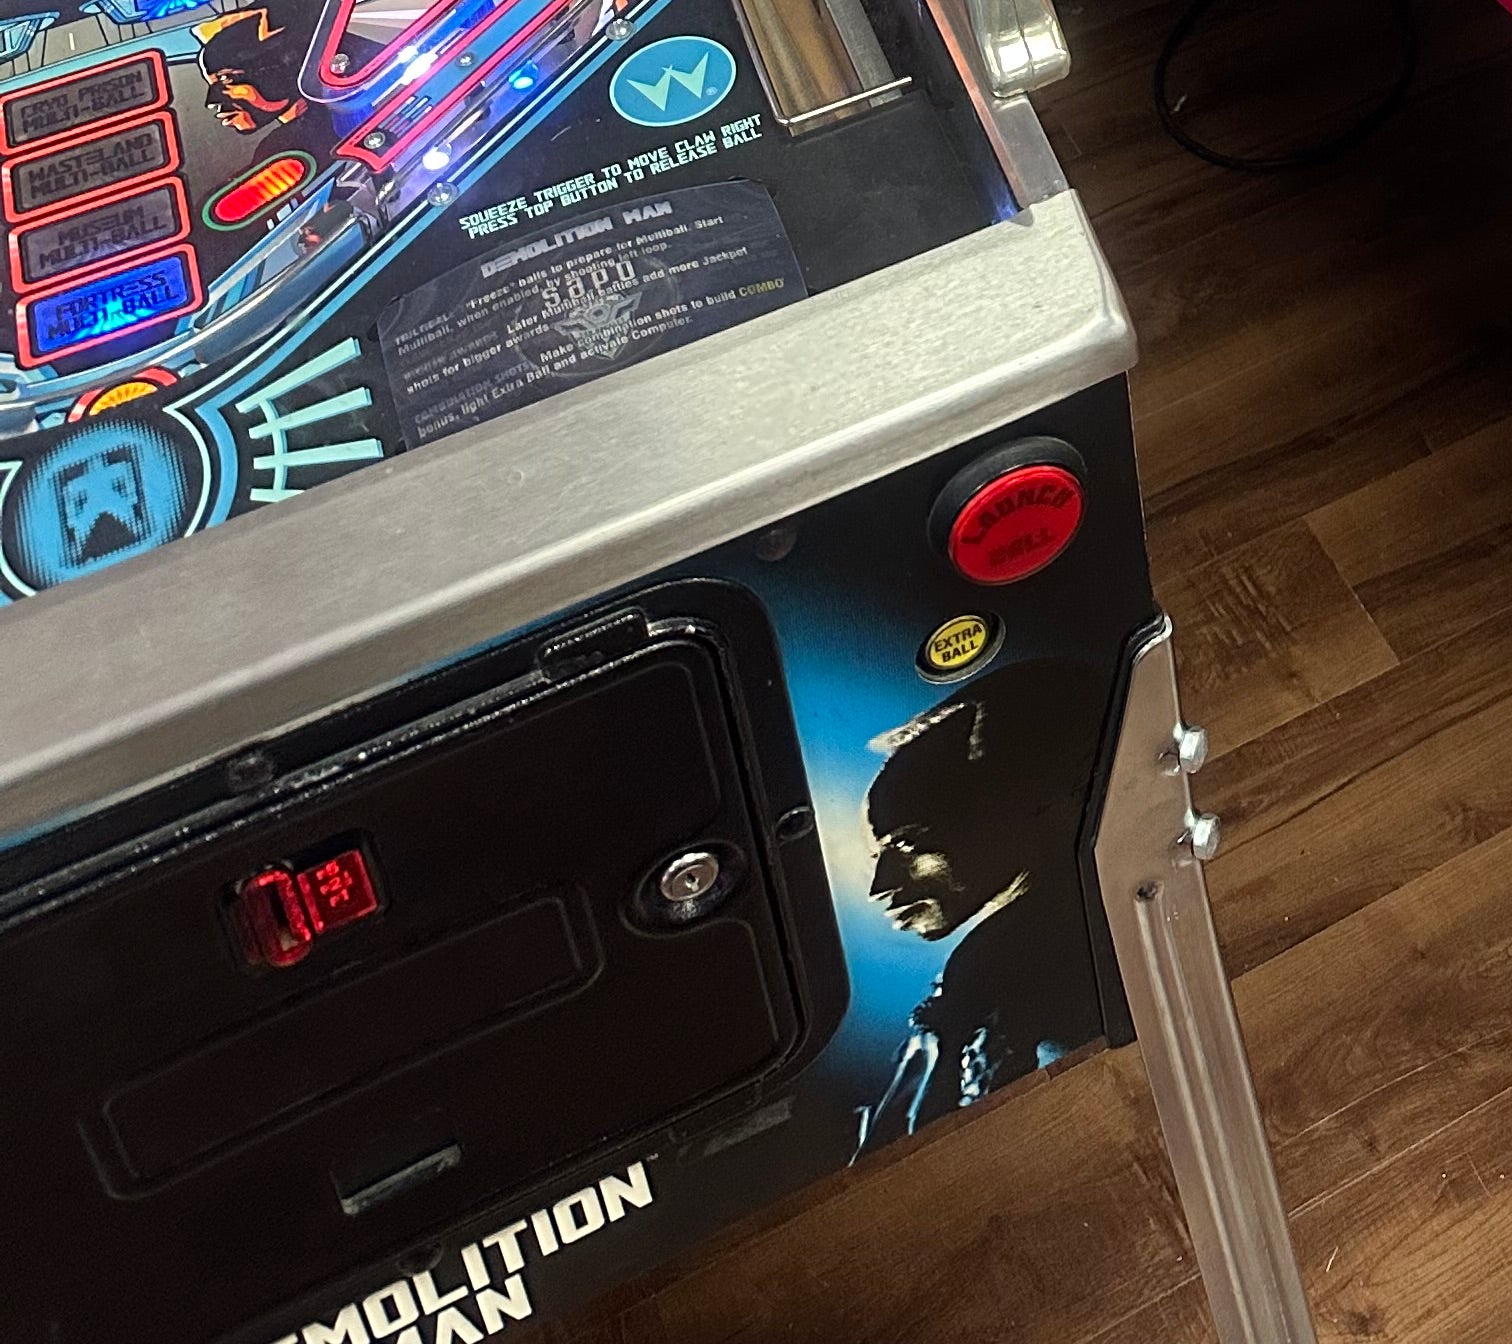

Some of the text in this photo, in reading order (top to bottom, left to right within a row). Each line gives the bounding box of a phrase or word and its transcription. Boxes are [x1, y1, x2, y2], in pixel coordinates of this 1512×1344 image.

[459, 113, 762, 231] SQUEEZE TRIGGER TO MOVE CLAW RIGHT
[468, 127, 762, 240] PRESS TOP BUTTON TO RELEASE BALL
[480, 200, 674, 279] DEMOLITION MAN
[518, 270, 548, 288] balls
[566, 245, 613, 270] prepare
[694, 215, 724, 230] Start
[56, 270, 166, 320] FORTRESS
[457, 309, 489, 327] when
[564, 257, 616, 281] shooting
[506, 314, 538, 334] Later
[643, 268, 665, 282] add
[668, 259, 700, 275] more
[703, 245, 749, 267] Jackpot
[540, 342, 574, 363] Make
[577, 313, 652, 348] combination
[655, 303, 689, 321] shots
[705, 290, 737, 307] build
[738, 277, 785, 298] COMBO
[406, 372, 440, 395] shots
[462, 344, 502, 368] bigger
[505, 322, 550, 349] awards
[461, 393, 490, 418] light
[491, 379, 525, 399] Extra
[526, 364, 551, 385] Ball
[553, 353, 578, 372] and
[580, 334, 630, 361] activate
[960, 484, 1077, 545] LAUNCH
[933, 623, 983, 653] EXTRA
[941, 639, 979, 663] BALL
[268, 1160, 654, 1344] MOLITION
